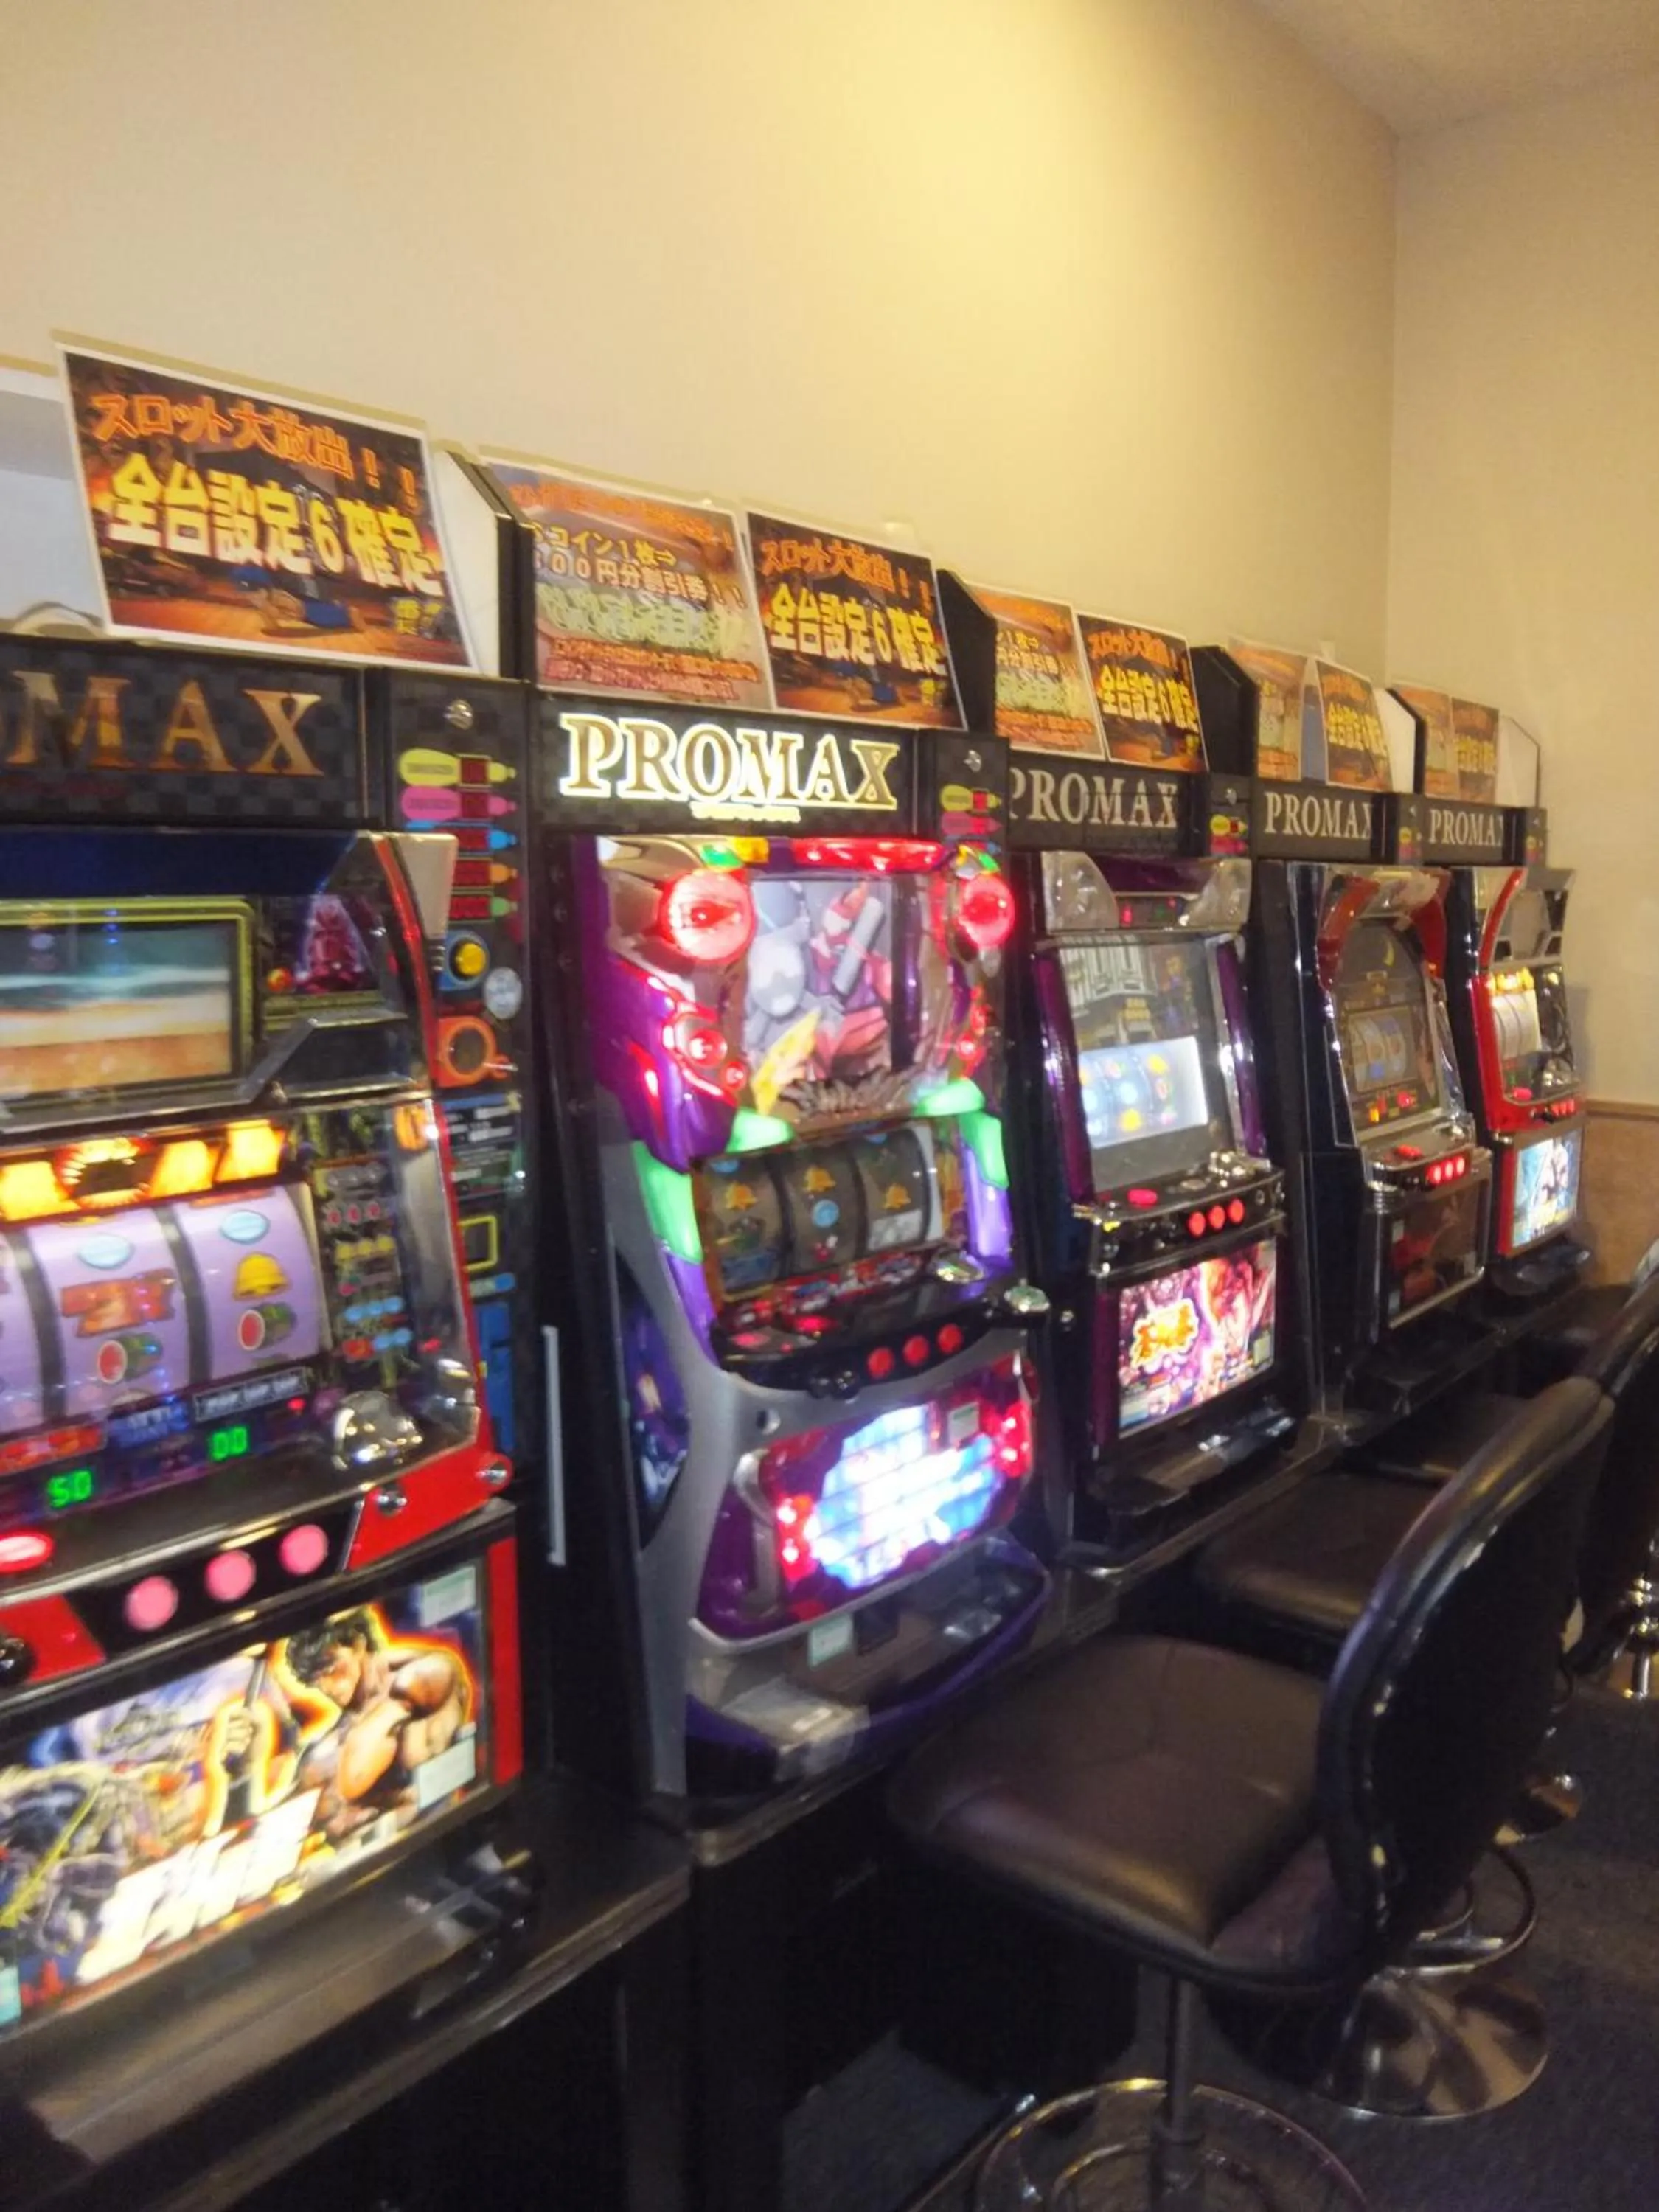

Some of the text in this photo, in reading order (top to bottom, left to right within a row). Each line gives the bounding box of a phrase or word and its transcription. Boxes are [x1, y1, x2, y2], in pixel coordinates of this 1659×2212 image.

[107, 451, 444, 596] 全台設定6確定
[559, 712, 901, 811] PROMAX
[46, 1470, 92, 1509] 50
